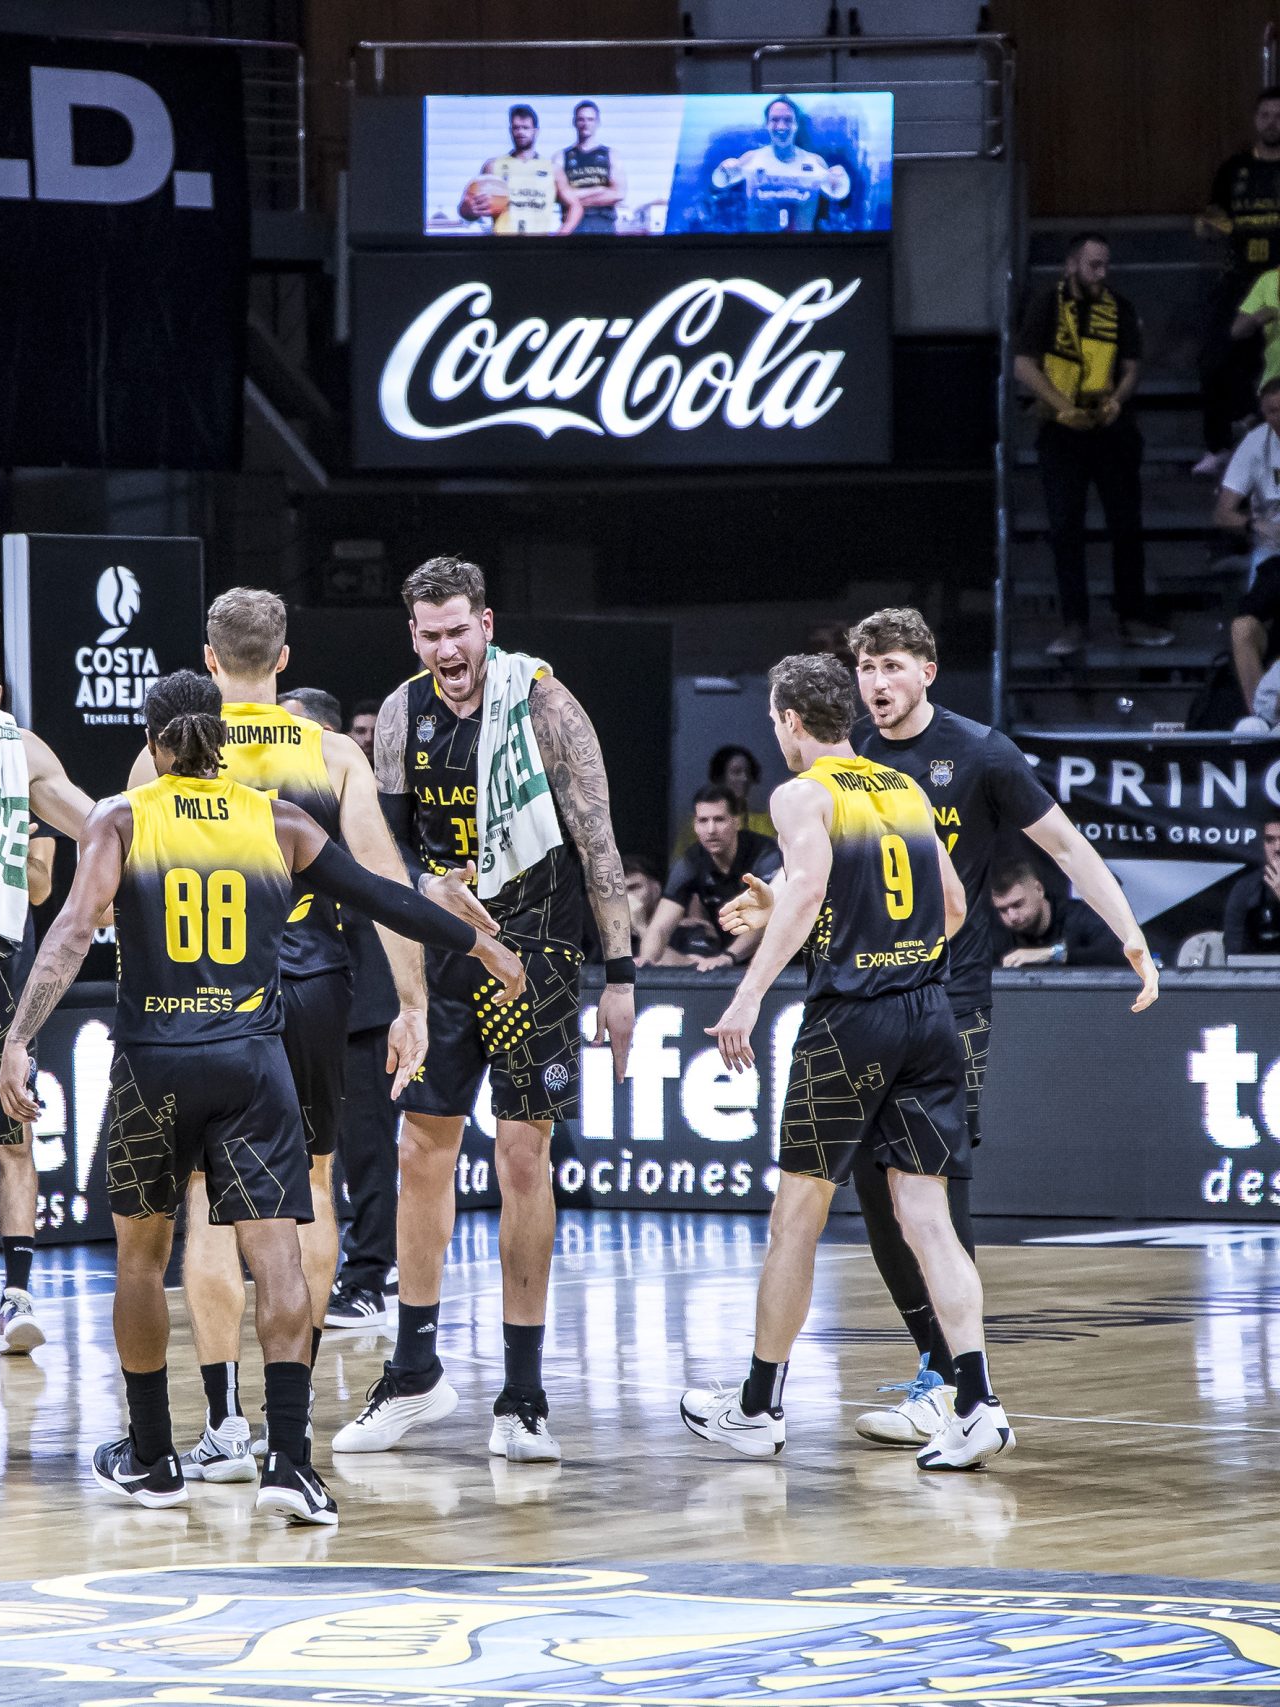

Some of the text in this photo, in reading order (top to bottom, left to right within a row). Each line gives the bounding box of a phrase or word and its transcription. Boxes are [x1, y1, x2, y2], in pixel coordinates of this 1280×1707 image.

[379, 277, 861, 440] Coca-Cola
[75, 647, 160, 675] COSTA
[226, 725, 302, 745] ROMAITIS
[1025, 753, 1280, 808] PRIN
[438, 786, 477, 806] LAG
[174, 795, 229, 821] MILLS
[1170, 826, 1257, 845] GROUP
[881, 834, 913, 920] 9
[164, 867, 246, 964] 88
[894, 940, 925, 949] IBERIA
[856, 950, 930, 968] EXPRESS
[196, 987, 232, 996] IBERIA
[144, 996, 233, 1014] EXPRESS
[559, 1148, 753, 1196] ociones
